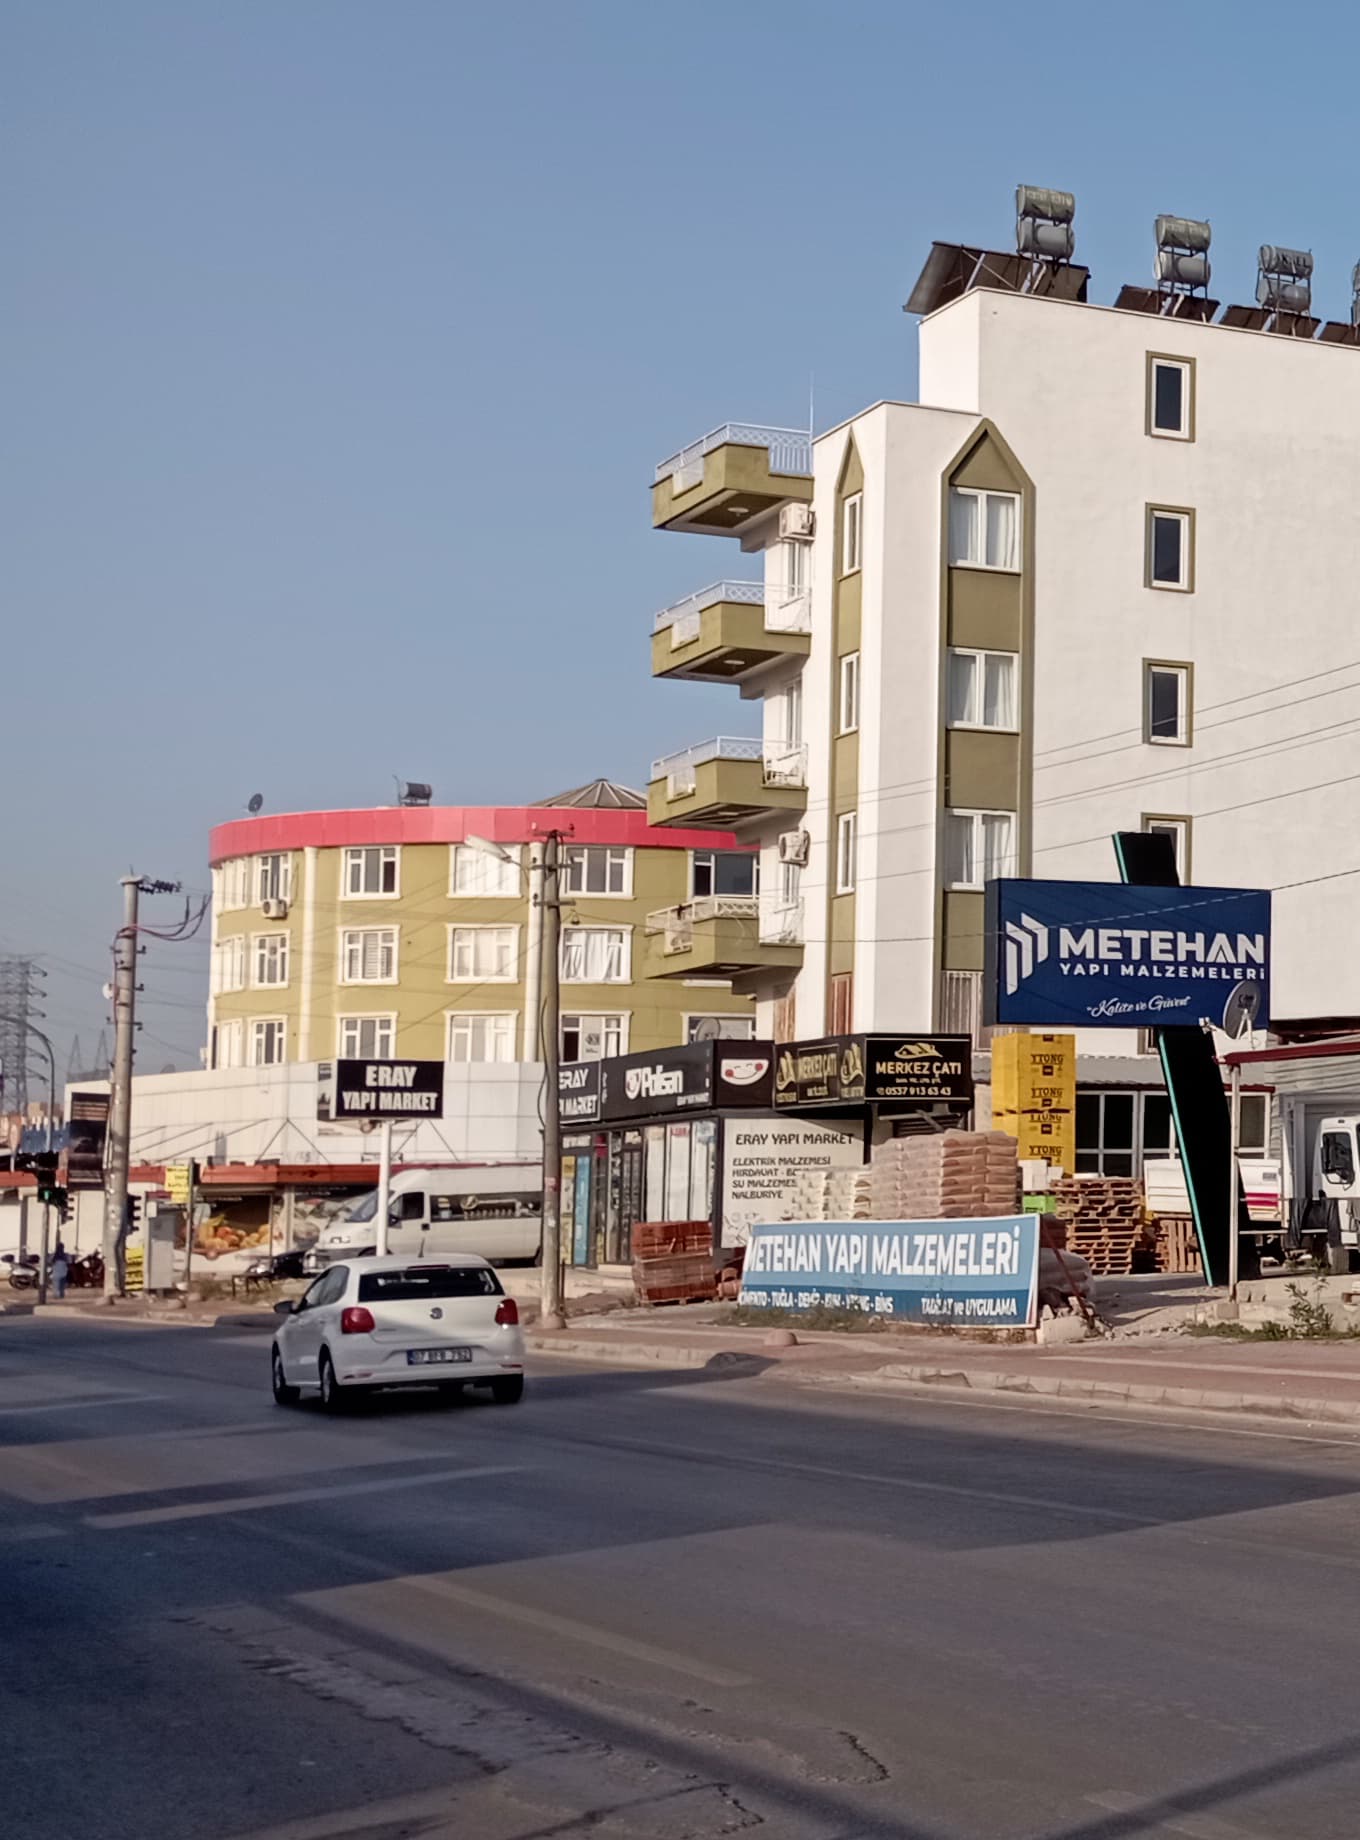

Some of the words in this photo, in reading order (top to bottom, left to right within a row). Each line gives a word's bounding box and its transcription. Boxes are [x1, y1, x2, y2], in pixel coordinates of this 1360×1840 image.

[1059, 927, 1265, 964] METEHAN
[1060, 963, 1110, 977] YAPI
[1120, 964, 1265, 980] MALZEMELERİ
[365, 1065, 418, 1087] ERAY
[875, 1061, 931, 1075] MERKEZ
[932, 1061, 962, 1078] ÇATI
[342, 1091, 377, 1111] YAPI
[379, 1091, 438, 1111] MARKET
[735, 1133, 769, 1145] ERAY
[771, 1133, 800, 1145] YAPI
[803, 1133, 855, 1145] MARKET
[1029, 1145, 1063, 1157] YTONG
[732, 1179, 745, 1188] SU
[824, 1234, 868, 1275] YAPI
[872, 1225, 1019, 1275] MALZEMELERİ
[965, 1297, 1018, 1316] UYGULAMA
